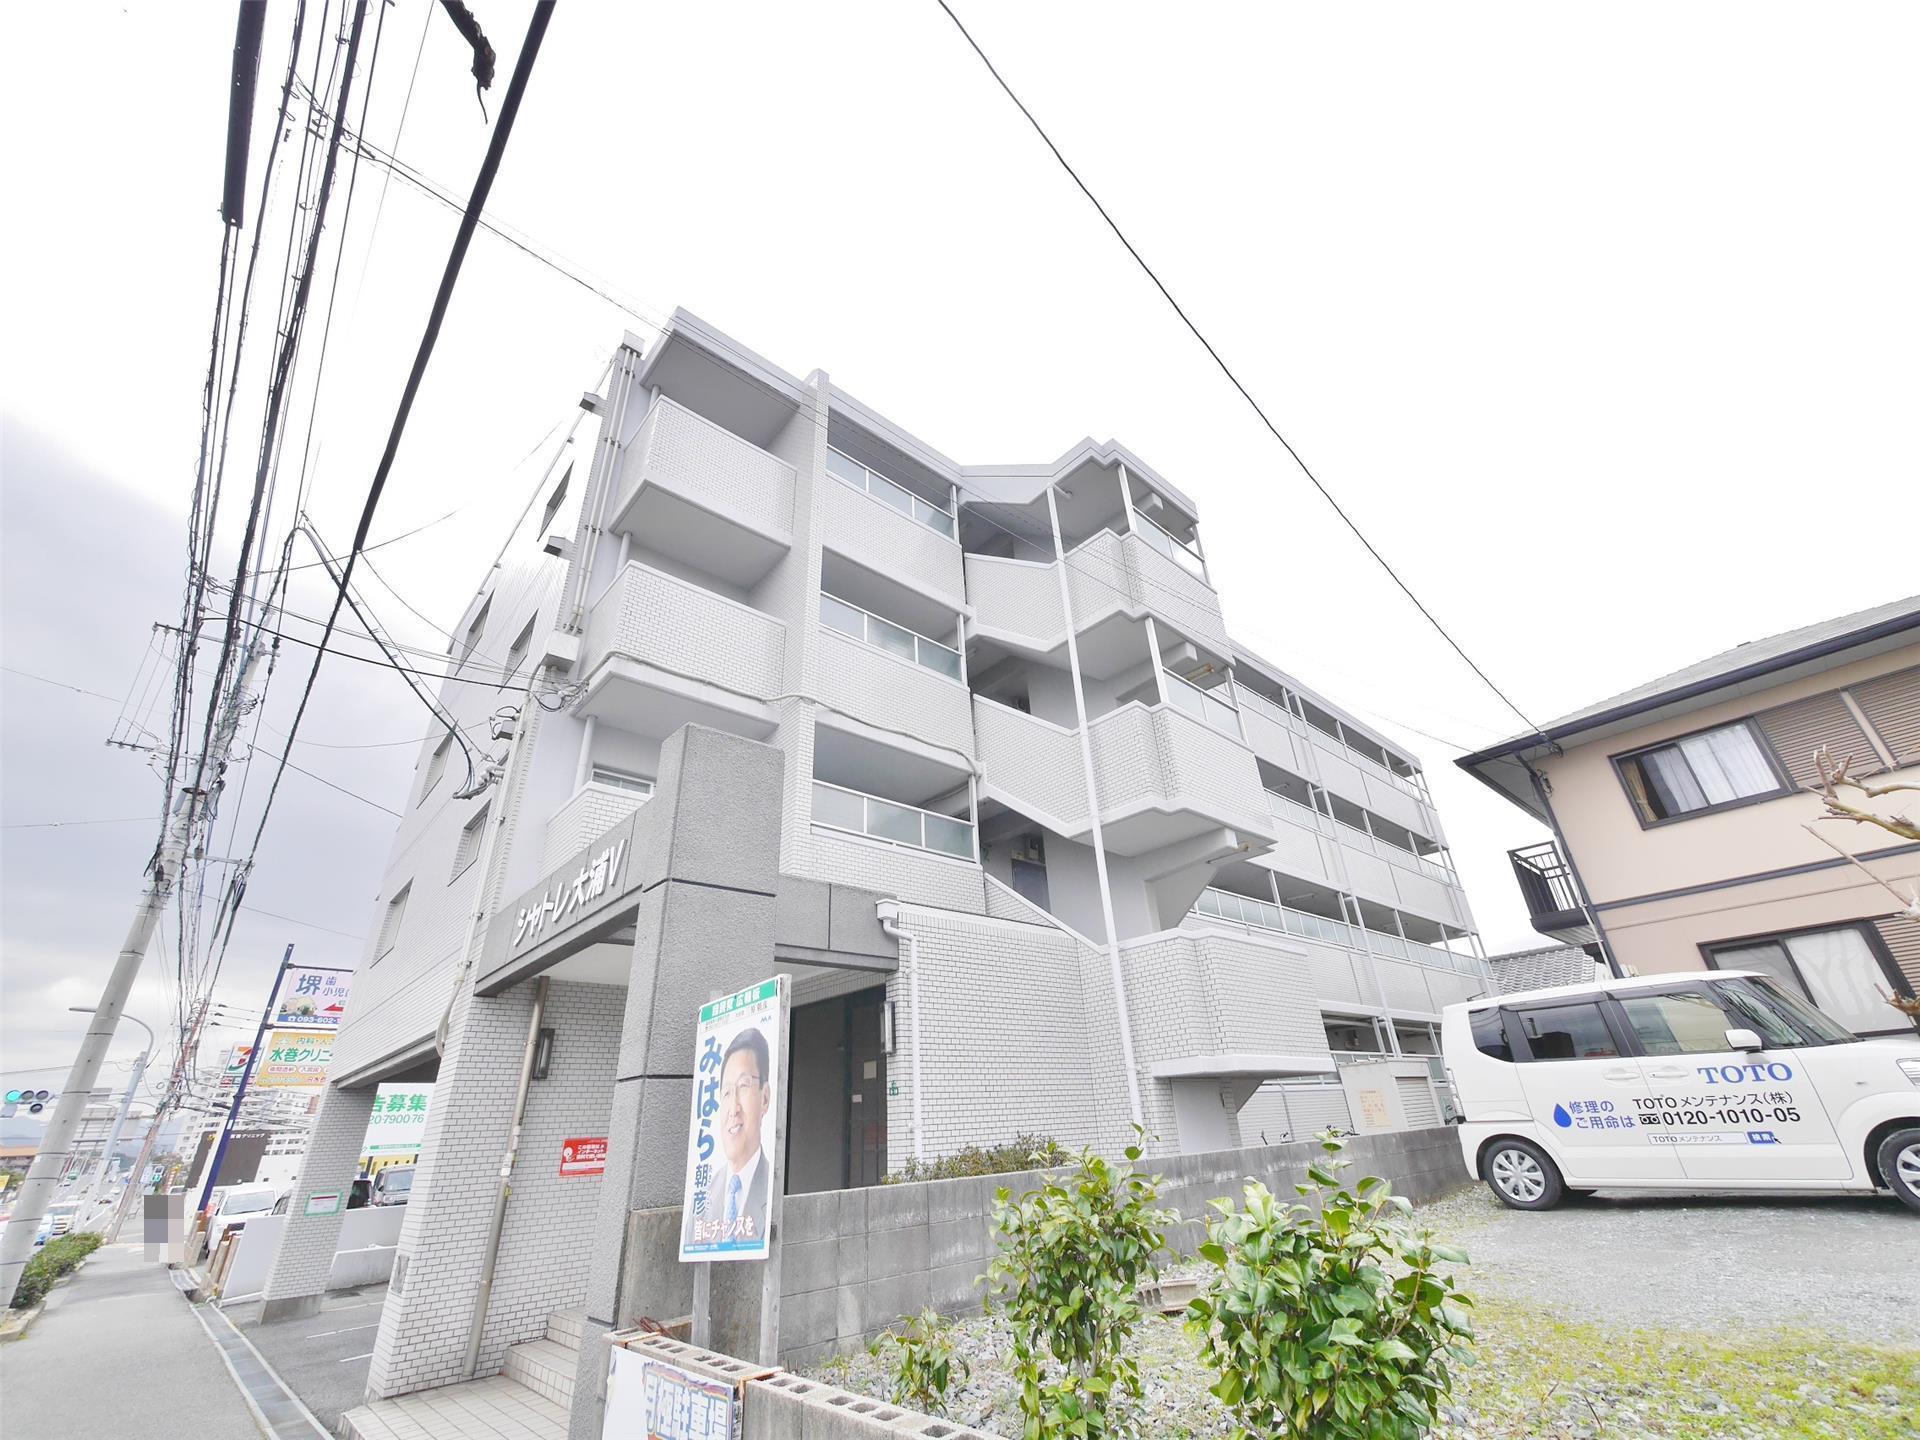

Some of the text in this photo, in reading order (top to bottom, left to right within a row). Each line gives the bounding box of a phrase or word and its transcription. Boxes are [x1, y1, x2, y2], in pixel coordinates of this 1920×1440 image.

[295, 974, 323, 995] 堺
[1696, 1062, 1793, 1084] TOTO
[1568, 1100, 1614, 1114] 修理の
[1632, 1097, 1678, 1110] TOTO
[1575, 1114, 1636, 1130] ご用命は
[1662, 1107, 1801, 1126] 0120-1010-05
[693, 1035, 722, 1216] みはら 朝彦
[1652, 1135, 1678, 1143] TOTO
